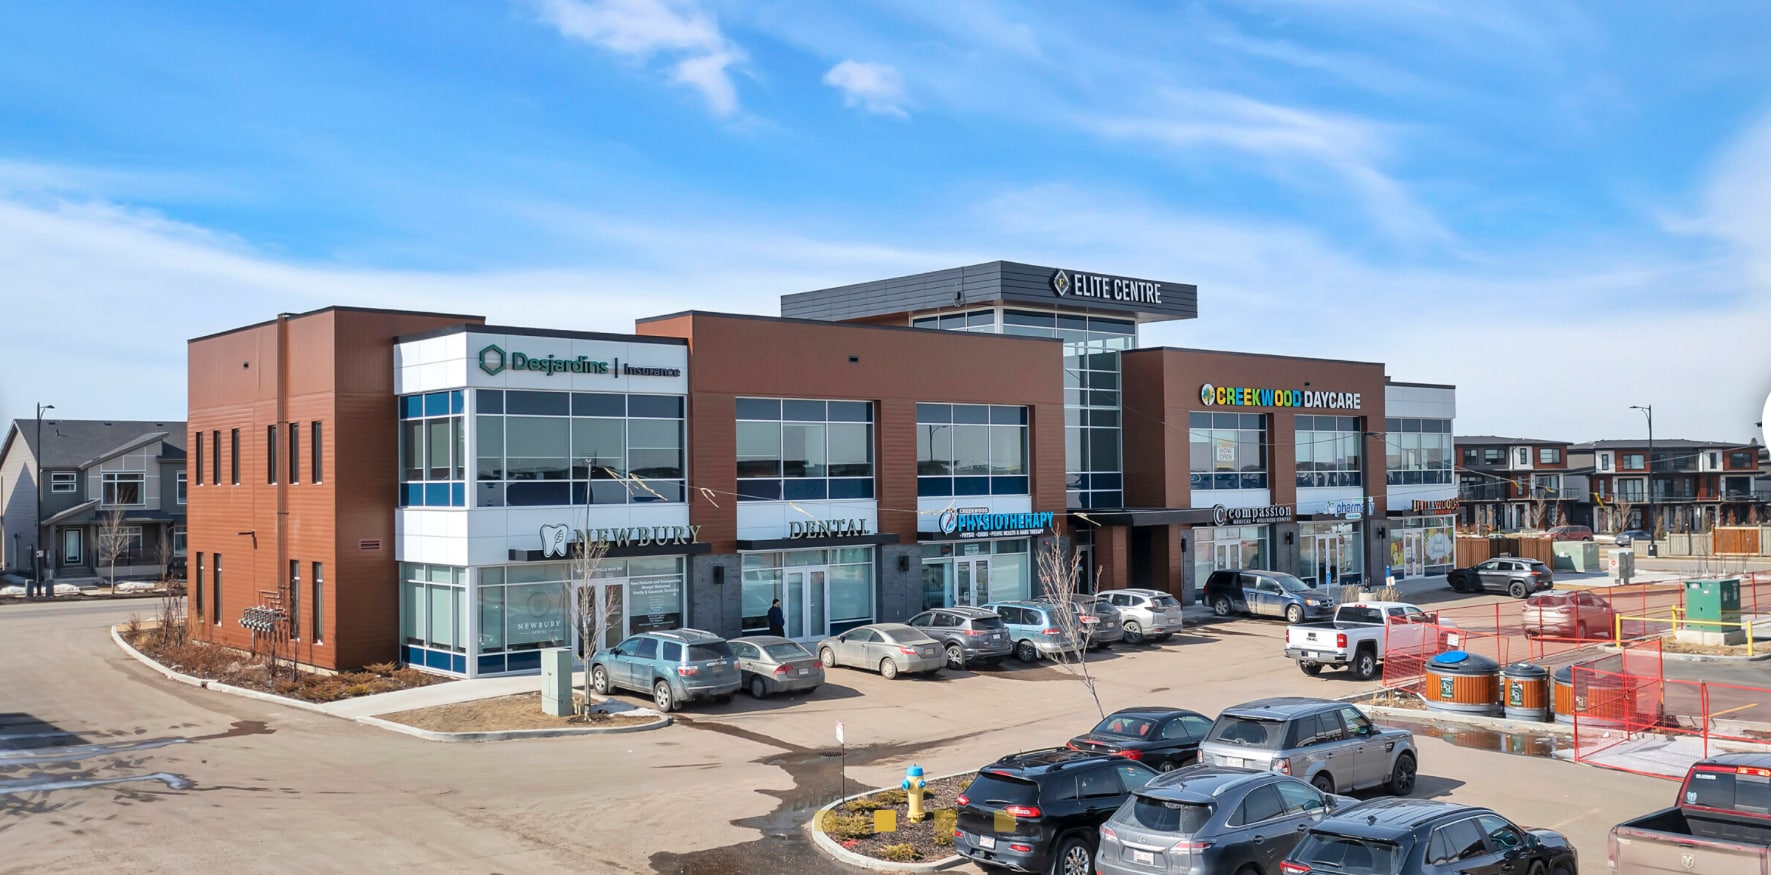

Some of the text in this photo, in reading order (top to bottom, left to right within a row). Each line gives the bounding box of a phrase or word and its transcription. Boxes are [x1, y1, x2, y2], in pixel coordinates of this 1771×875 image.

[1074, 274, 1162, 303] ELITE CENTRE
[512, 352, 680, 377] Desjardins Insurance
[1216, 387, 1360, 409] CREEKWOOD DAYCARE
[958, 512, 1054, 531] PHYSIOTHERAPY
[1229, 505, 1291, 522] compassion
[574, 525, 702, 549] NEWBURY
[789, 519, 870, 539] DENTAL
[518, 621, 560, 630] NEWBURY
